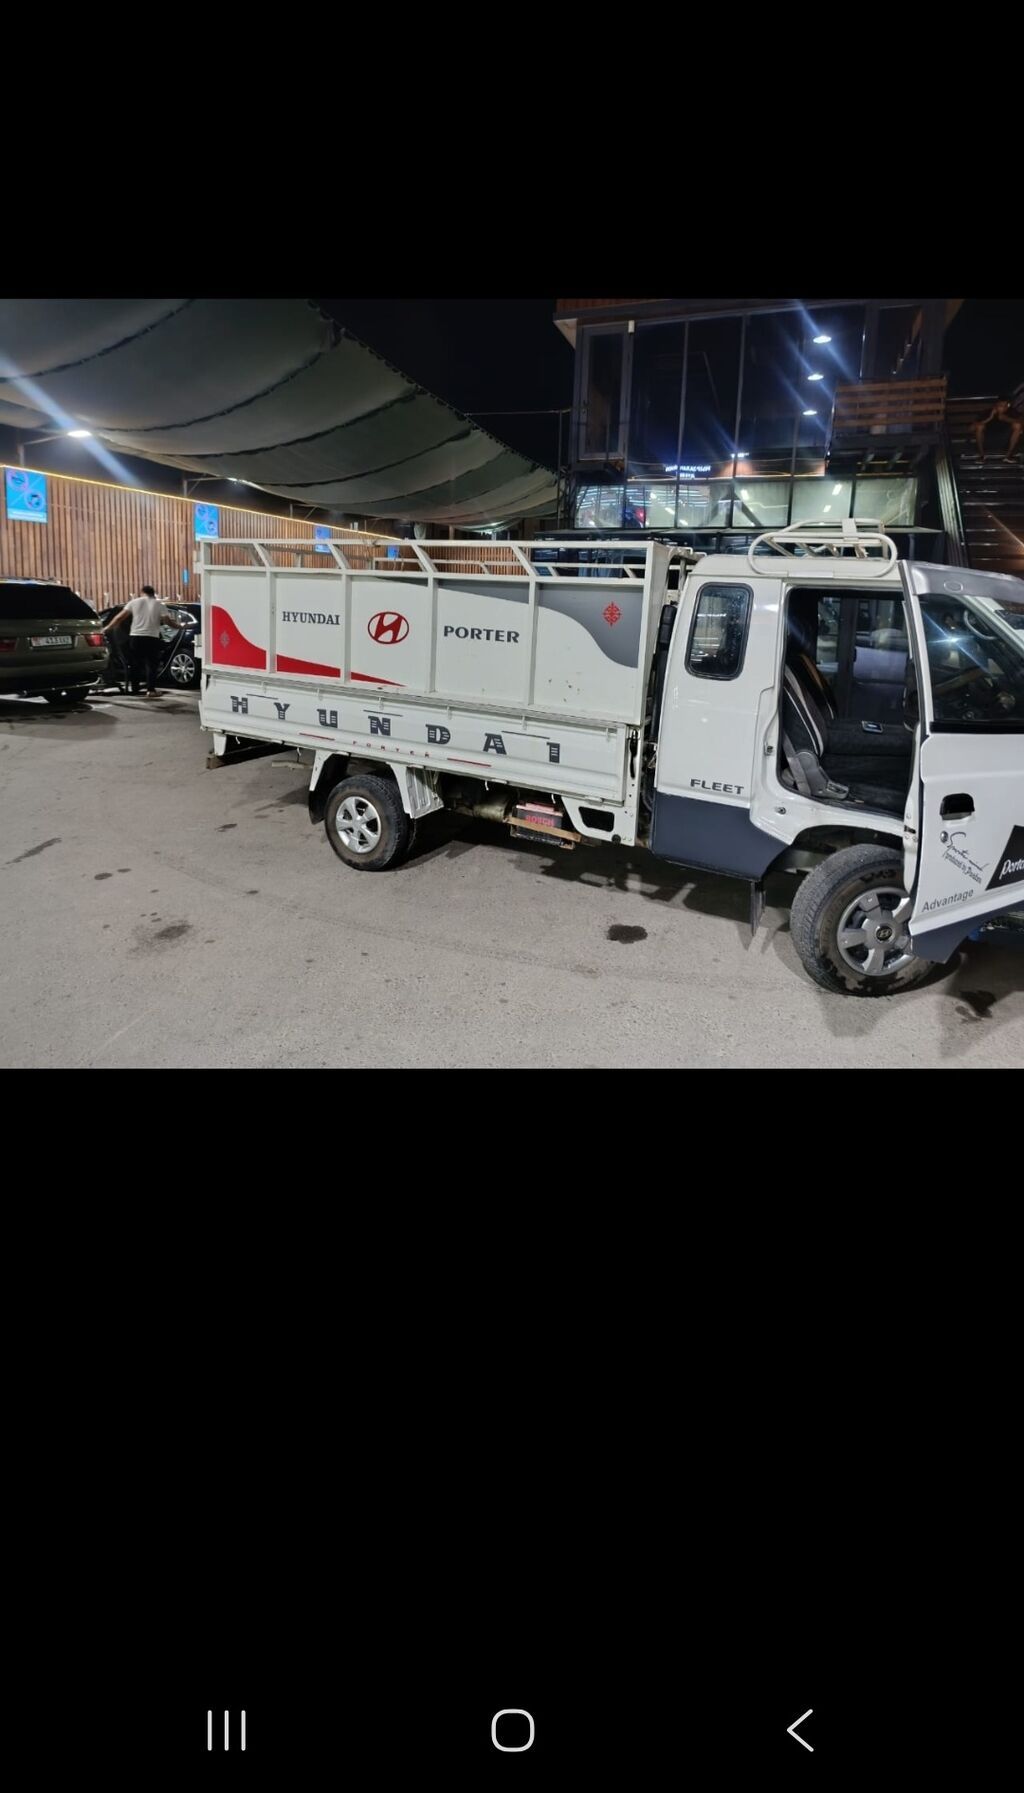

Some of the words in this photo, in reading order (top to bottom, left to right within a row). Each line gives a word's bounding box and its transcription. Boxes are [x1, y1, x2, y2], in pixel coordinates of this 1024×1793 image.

[282, 611, 341, 626] HYUNDAI
[443, 625, 521, 645] PORTER
[690, 777, 746, 796] FLEET
[922, 888, 975, 913] Advantage
